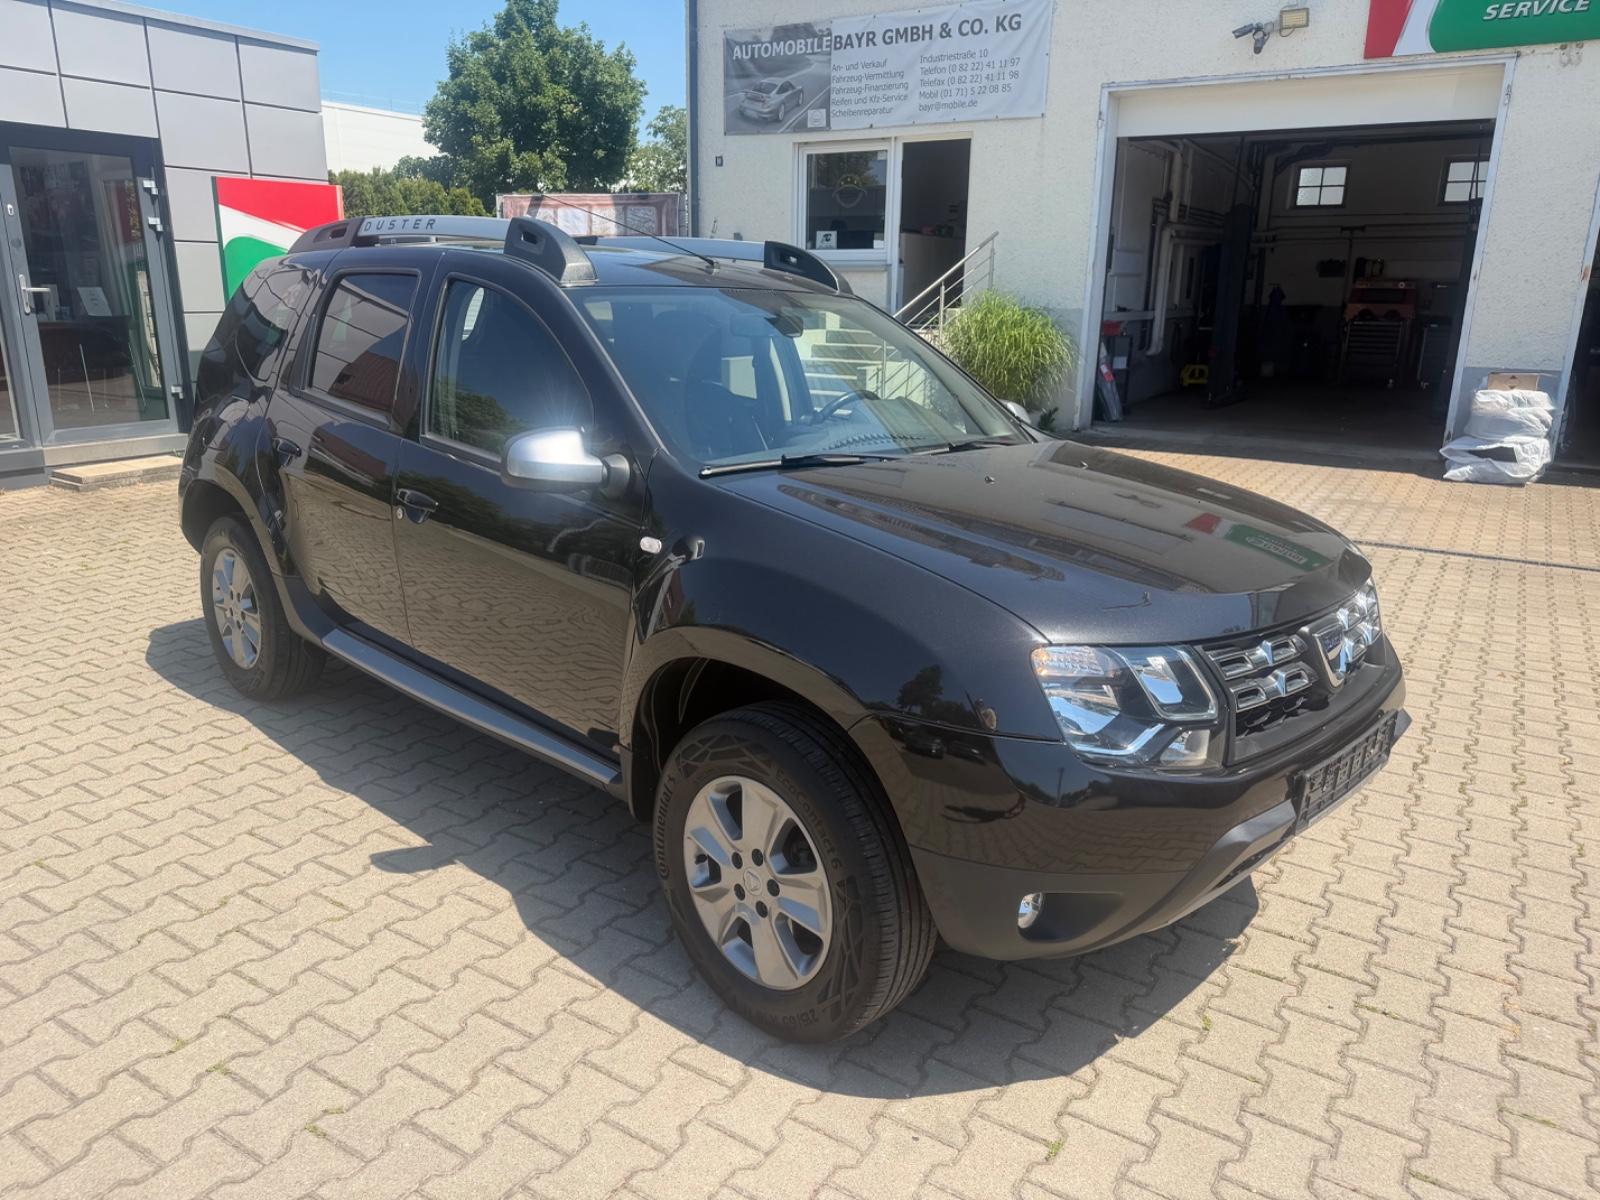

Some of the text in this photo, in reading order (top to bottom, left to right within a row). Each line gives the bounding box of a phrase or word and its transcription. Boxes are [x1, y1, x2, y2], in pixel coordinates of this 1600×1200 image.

[1483, 0, 1590, 20] SERVICE
[733, 13, 1022, 60] AUTOMOBILE BAYR GMBH & CO. KG
[920, 48, 988, 64] Industriestraße 10
[832, 58, 887, 72] An- und Verkauf
[920, 57, 1020, 76] Telefon (0 82 22) 41 11 97
[832, 70, 905, 84] Fahrzeug-Vermittlung
[920, 78, 945, 88] Telefax
[947, 76, 956, 87] (0
[969, 74, 983, 85] 22)
[985, 73, 994, 82] 41
[998, 72, 1005, 81] 11
[832, 82, 909, 95] Fahrzeug-Finanzierung
[919, 83, 1012, 99] Mobil (01 71) 5 22 08 85
[832, 93, 909, 106] Reifen und Kfz-Service
[918, 99, 978, 112] bayr@mobile.de
[831, 106, 894, 118] Scheibenreparatur
[364, 218, 436, 232] DUSTER
